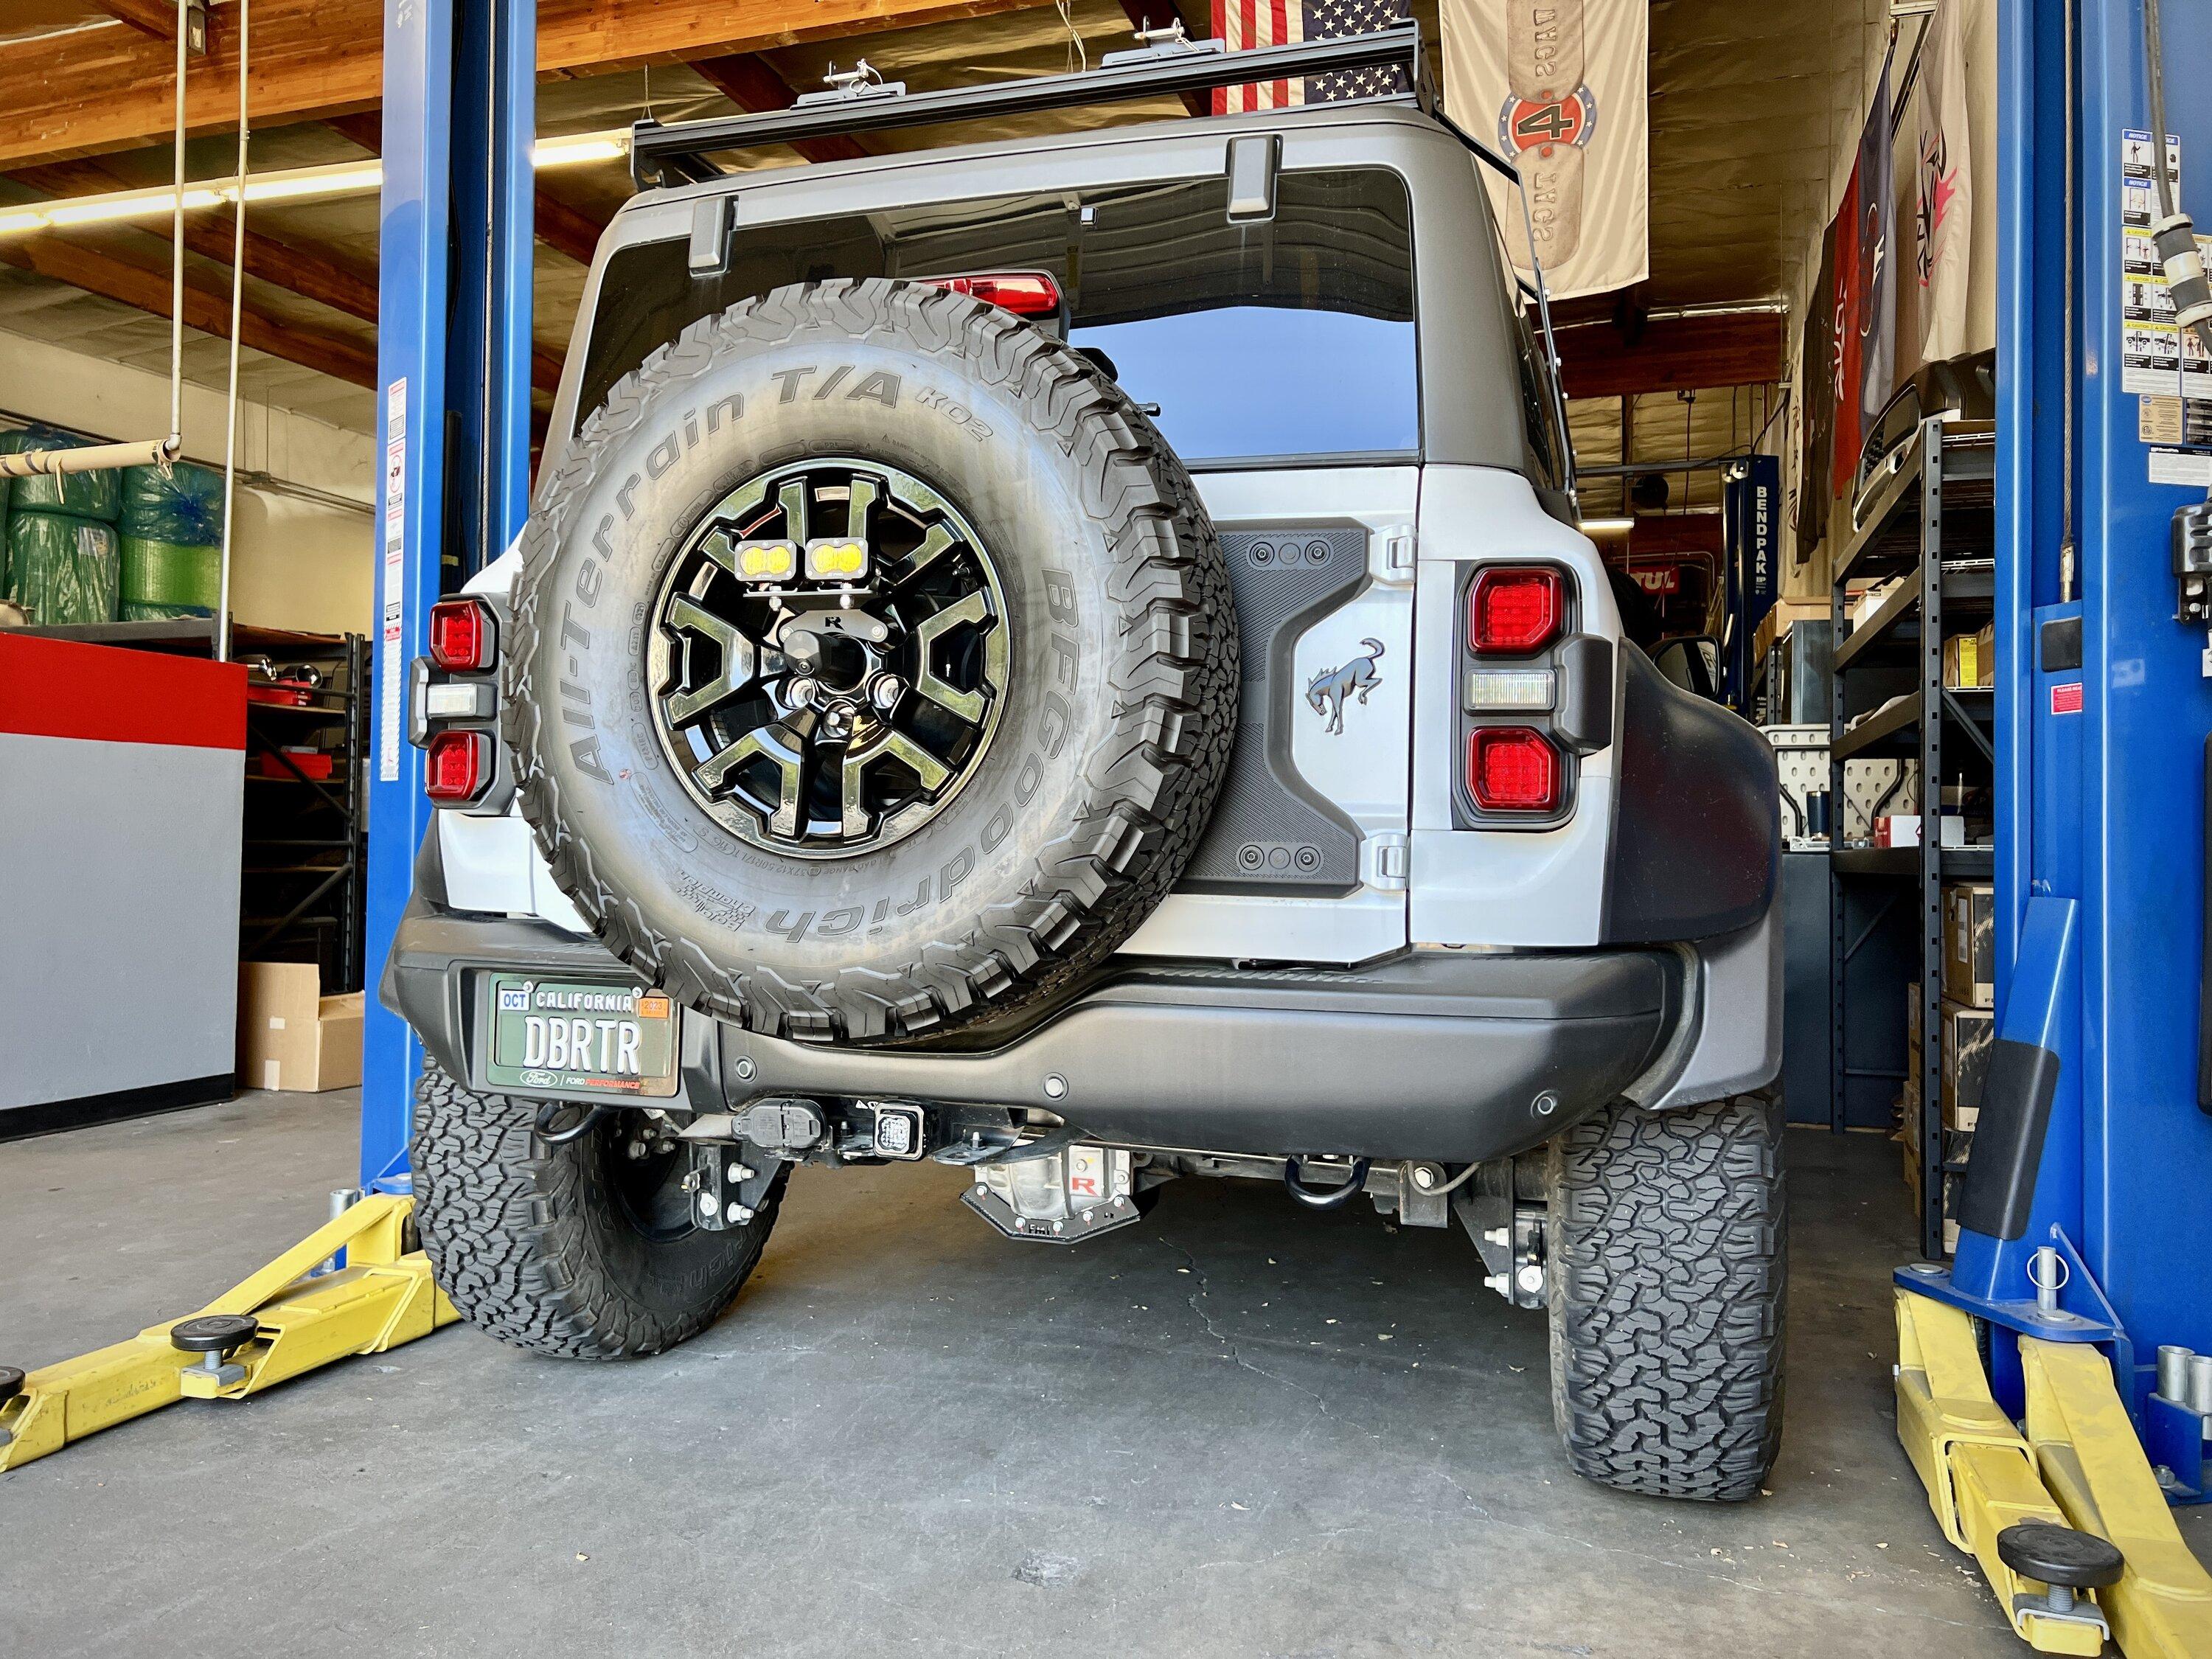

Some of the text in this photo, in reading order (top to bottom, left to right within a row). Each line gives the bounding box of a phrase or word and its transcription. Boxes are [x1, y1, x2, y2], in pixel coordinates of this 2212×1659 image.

[771, 364, 902, 408] T/A
[916, 386, 995, 442] KO2
[1756, 486, 1767, 574] BENDPAK
[1630, 571, 1675, 590] TUL
[824, 616, 845, 631] R
[765, 567, 1079, 943] BFGoodrich
[504, 993, 526, 1009] OCT
[535, 991, 633, 1013] CALIFORNIA
[644, 1001, 663, 1010] 2023
[522, 1015, 641, 1075] DBRTR
[525, 1071, 552, 1085] Ford
[566, 1077, 585, 1085] FORD
[1072, 1177, 1099, 1197] R
